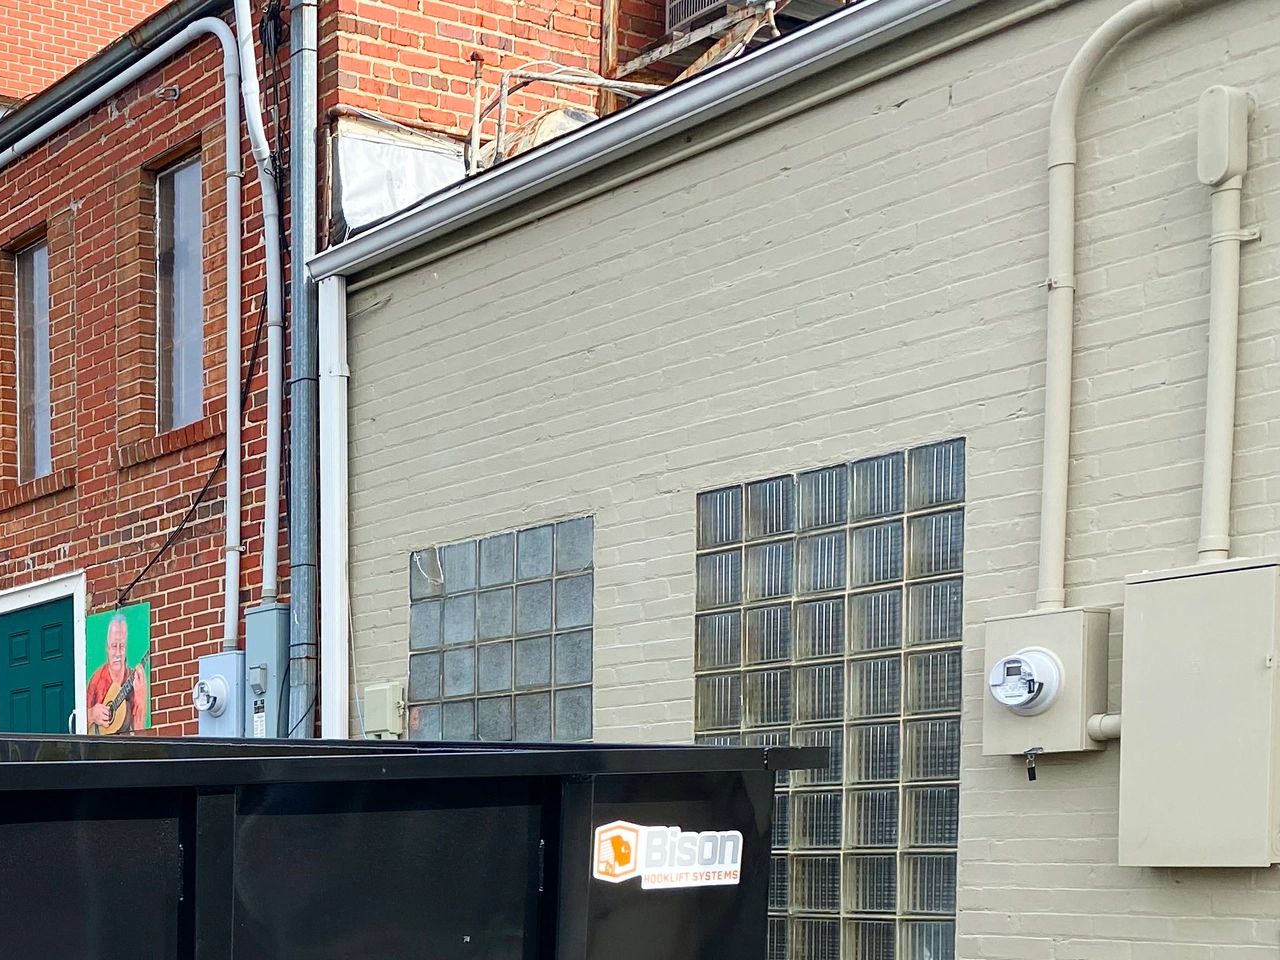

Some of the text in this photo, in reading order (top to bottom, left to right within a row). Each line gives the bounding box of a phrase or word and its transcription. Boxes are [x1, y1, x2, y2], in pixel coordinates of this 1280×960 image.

[645, 830, 740, 867] Bison
[644, 870, 738, 883] HOOKLIFT SYSTEMS
